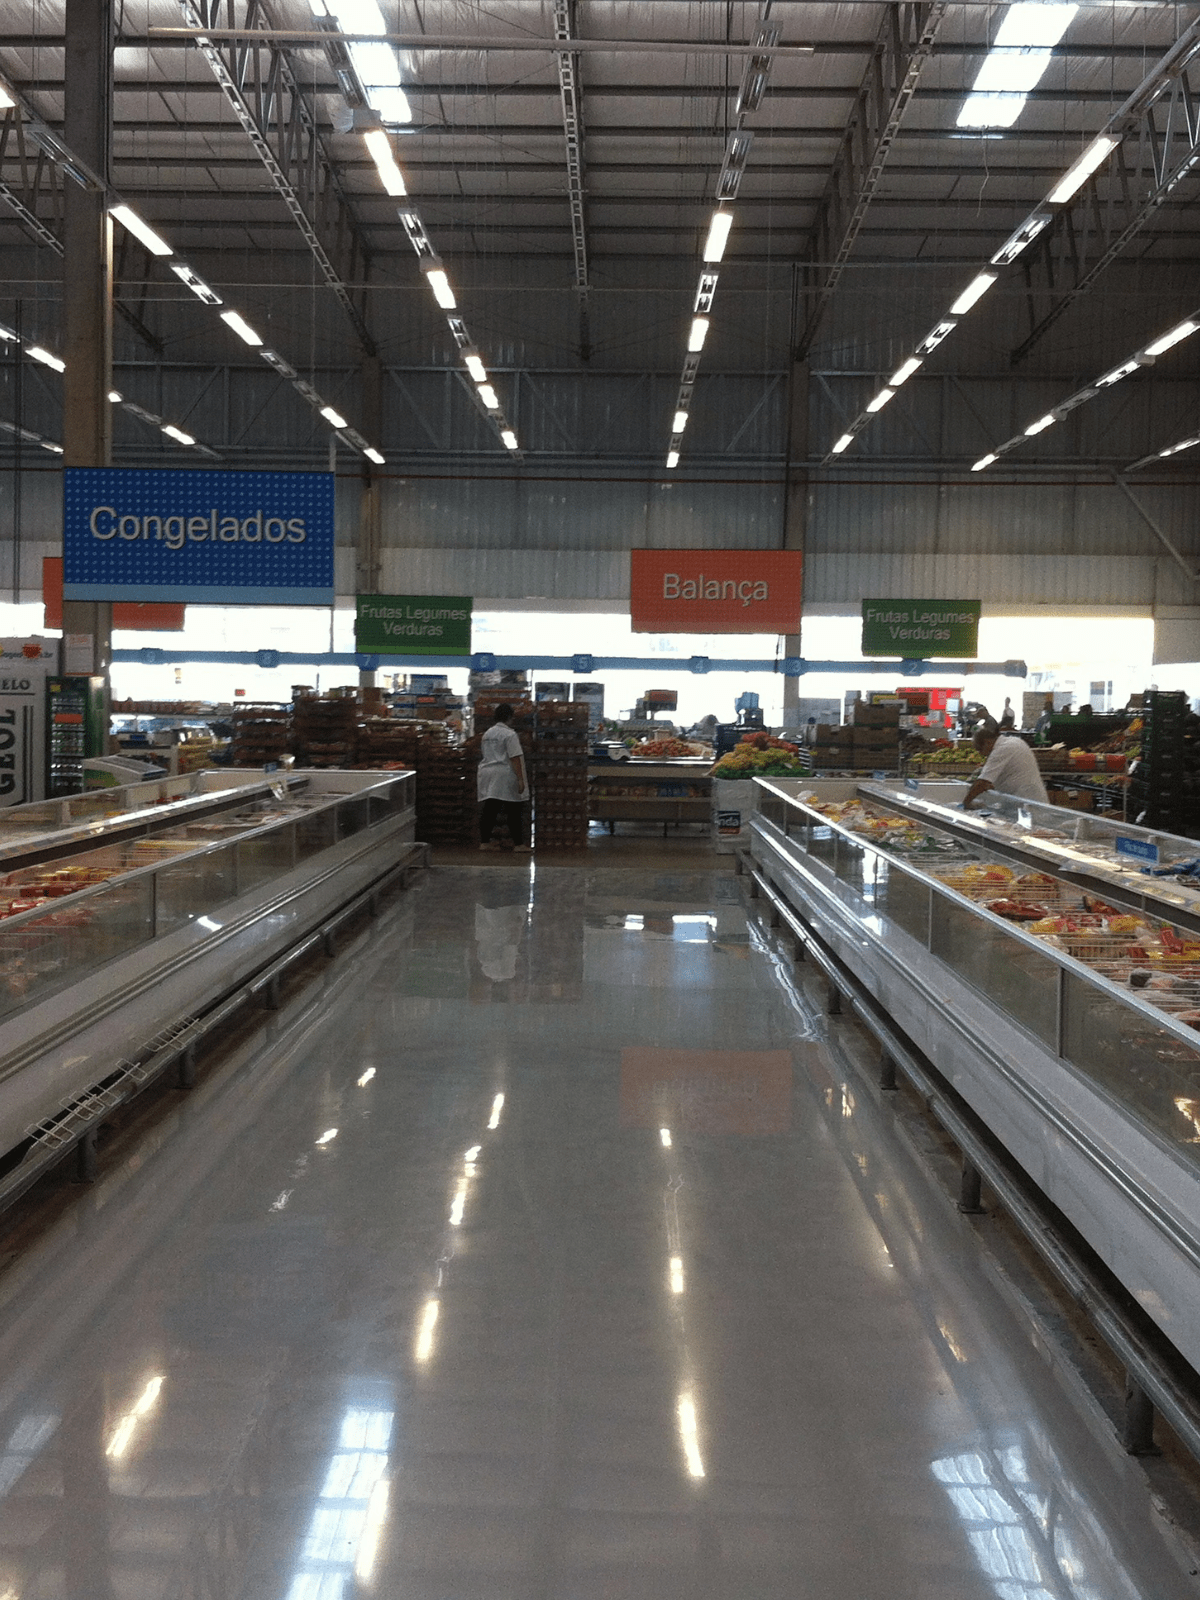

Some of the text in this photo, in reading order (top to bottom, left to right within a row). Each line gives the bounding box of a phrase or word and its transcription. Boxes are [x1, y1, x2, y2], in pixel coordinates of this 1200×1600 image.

[90, 506, 307, 549] Congelados
[663, 573, 768, 607] Balança
[361, 604, 467, 622] Frutas Legumes
[866, 609, 975, 626] Frutas Legumes
[383, 621, 443, 636] Verduras
[889, 626, 951, 640] Verduras
[362, 654, 372, 667] 7
[480, 655, 489, 668] 6
[579, 656, 589, 669] 5
[695, 659, 704, 672] 4
[792, 659, 801, 672] 3
[908, 662, 918, 674] 2
